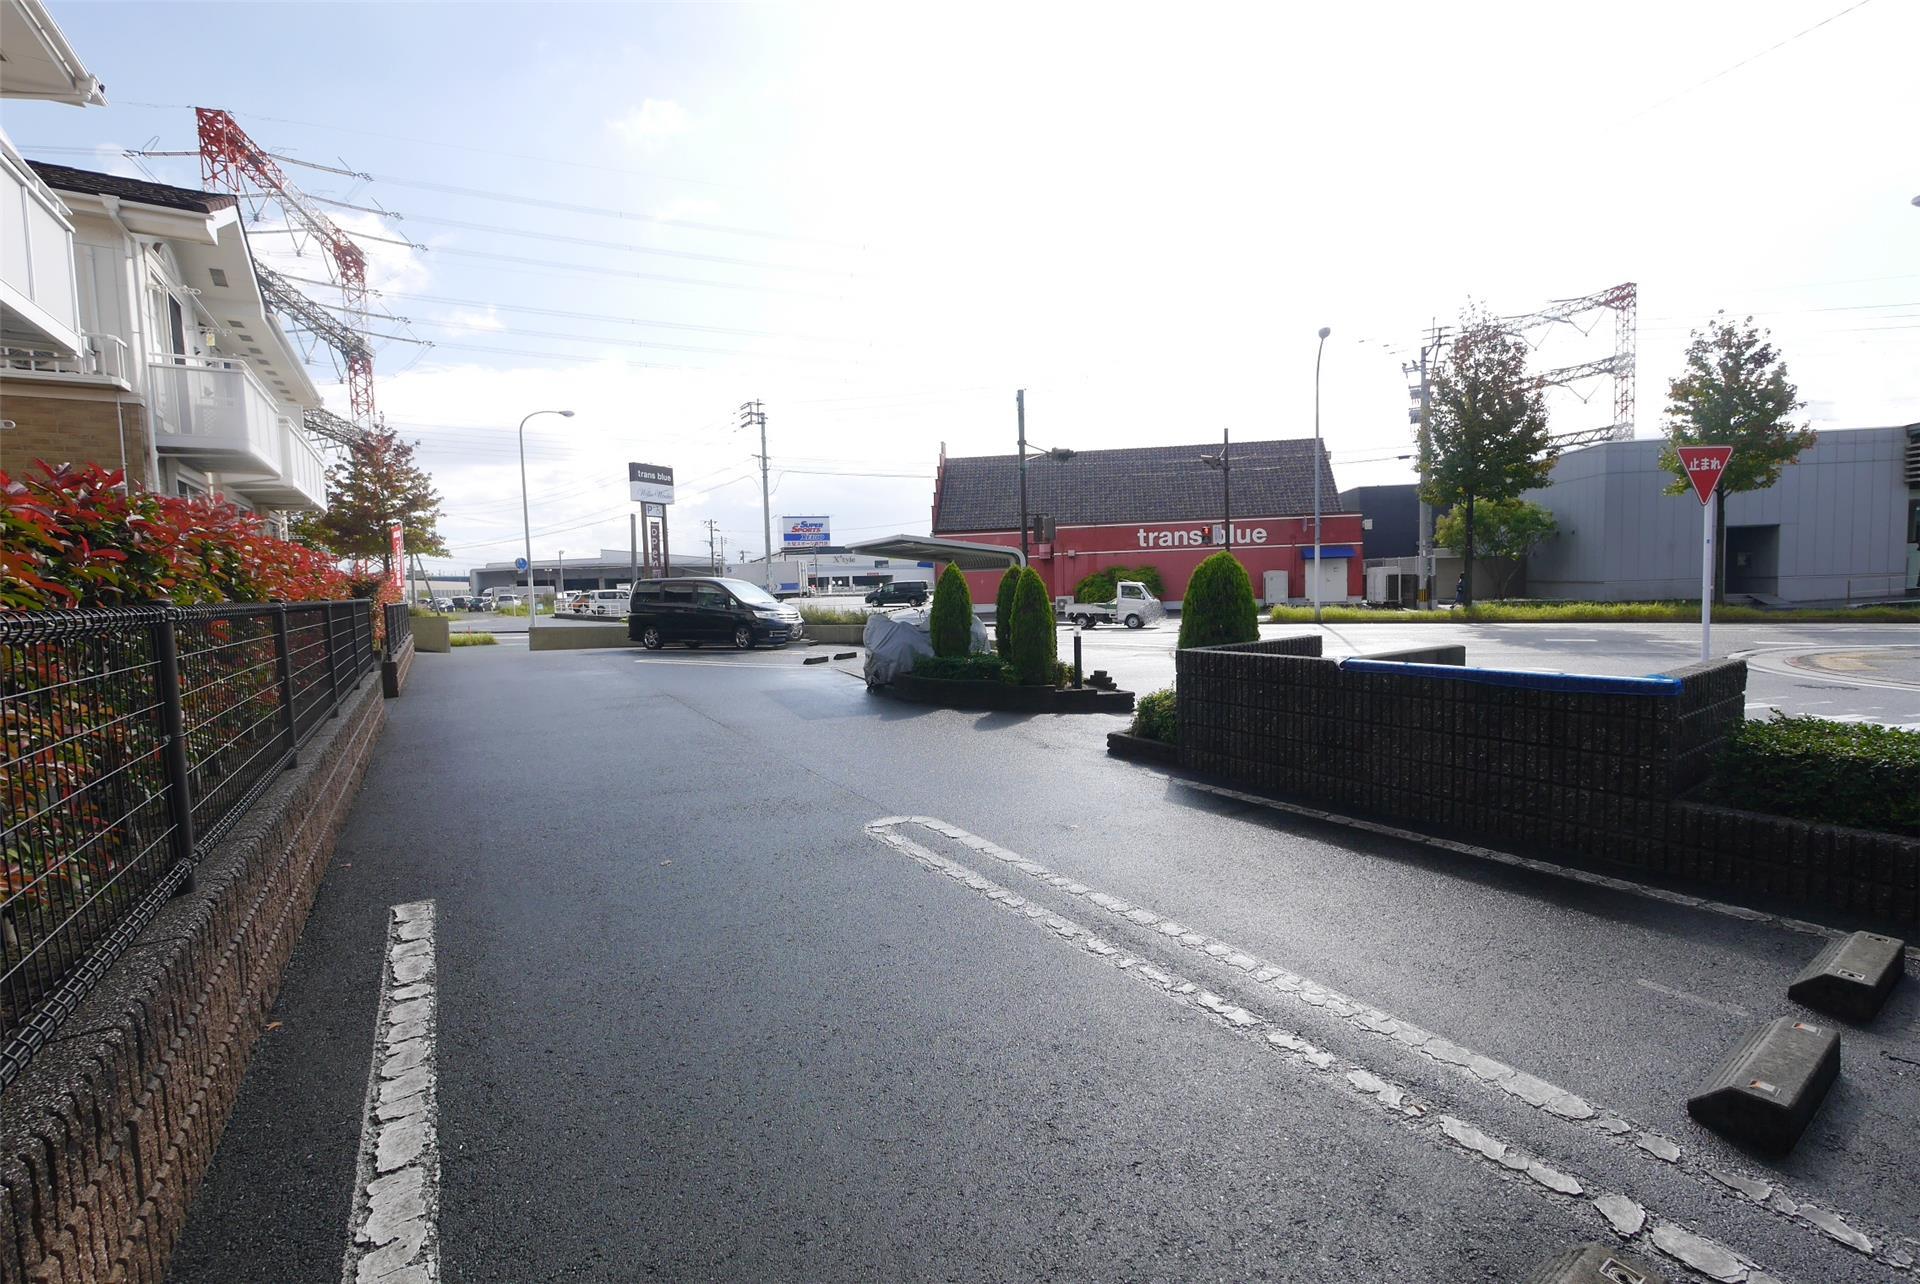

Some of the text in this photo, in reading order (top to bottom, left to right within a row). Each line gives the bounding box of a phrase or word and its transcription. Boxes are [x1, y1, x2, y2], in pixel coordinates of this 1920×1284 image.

[1689, 457, 1721, 471] 止まれ
[637, 470, 672, 482] trans blue
[1137, 528, 1203, 547] trans
